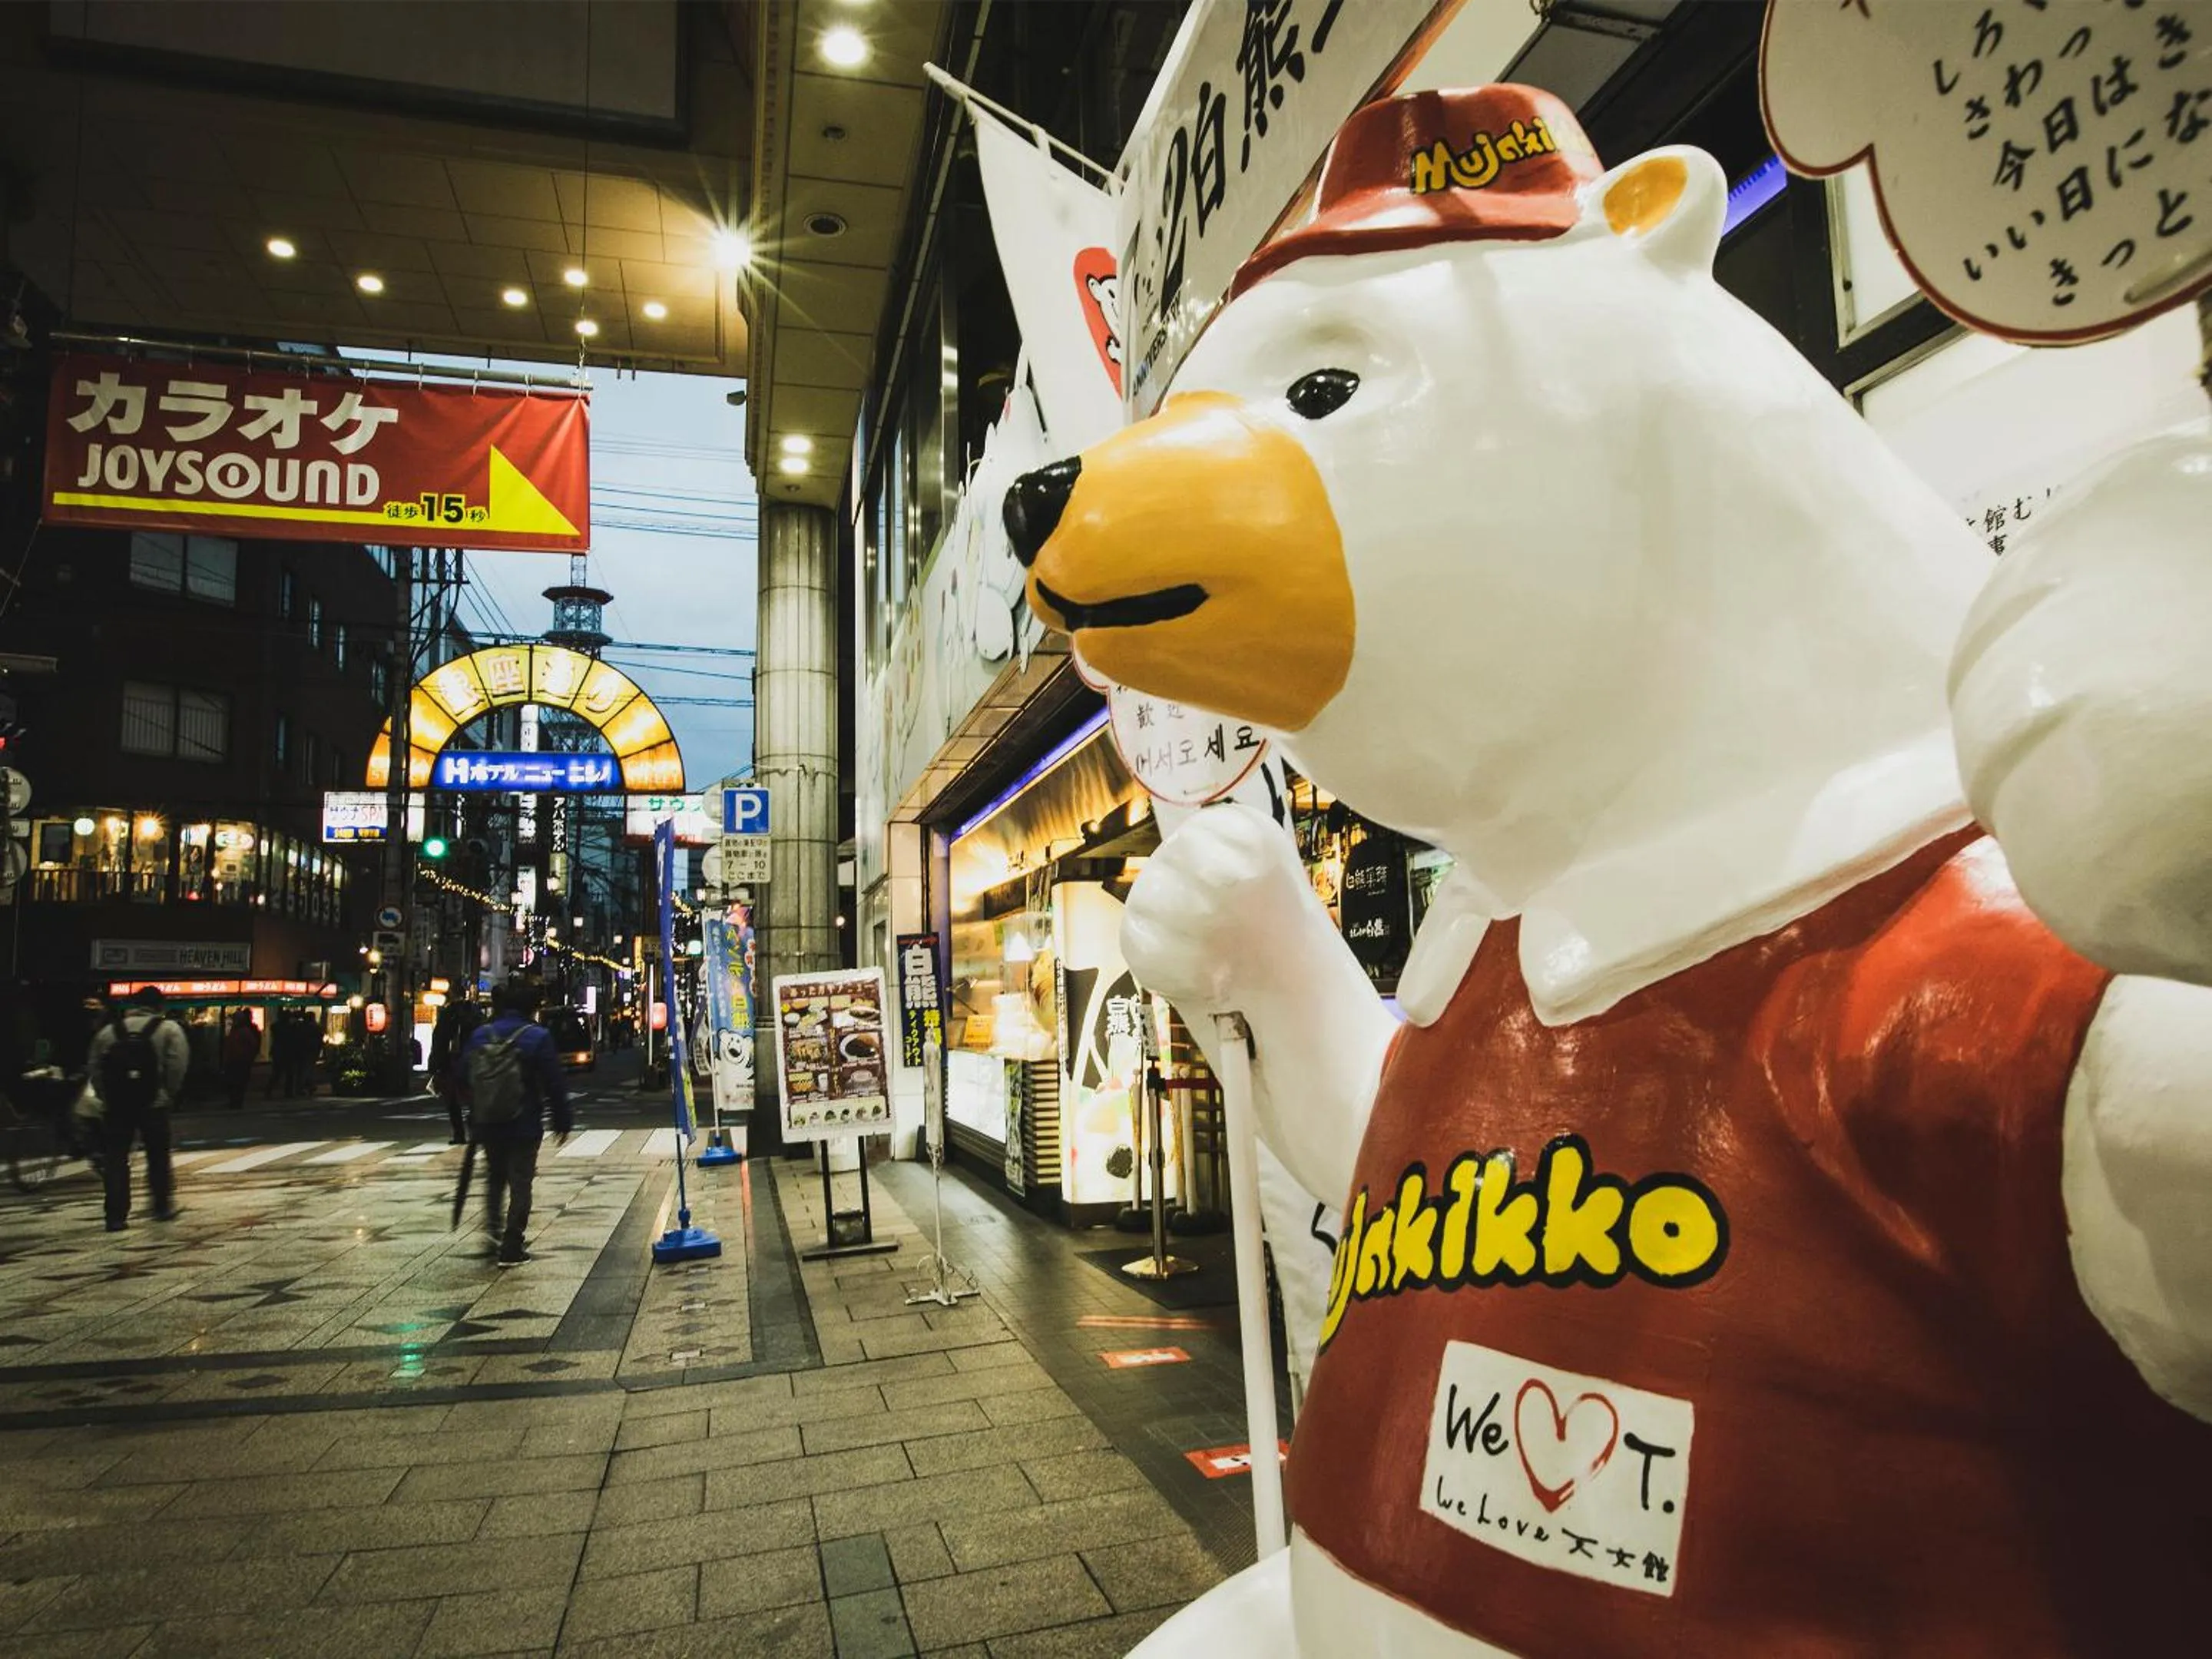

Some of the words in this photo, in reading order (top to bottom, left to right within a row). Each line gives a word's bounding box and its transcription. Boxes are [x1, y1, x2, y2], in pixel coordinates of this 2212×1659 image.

[1933, 0, 2048, 95] しろ
[1964, 0, 2144, 141] さわっ
[1410, 116, 1556, 194] Mujaki
[2052, 188, 2194, 306] きっと
[67, 372, 399, 455] カラオケ
[78, 443, 380, 505] JOYSOUND
[735, 793, 762, 830] P
[905, 943, 938, 1009] 白熊
[1446, 1383, 1509, 1456] We
